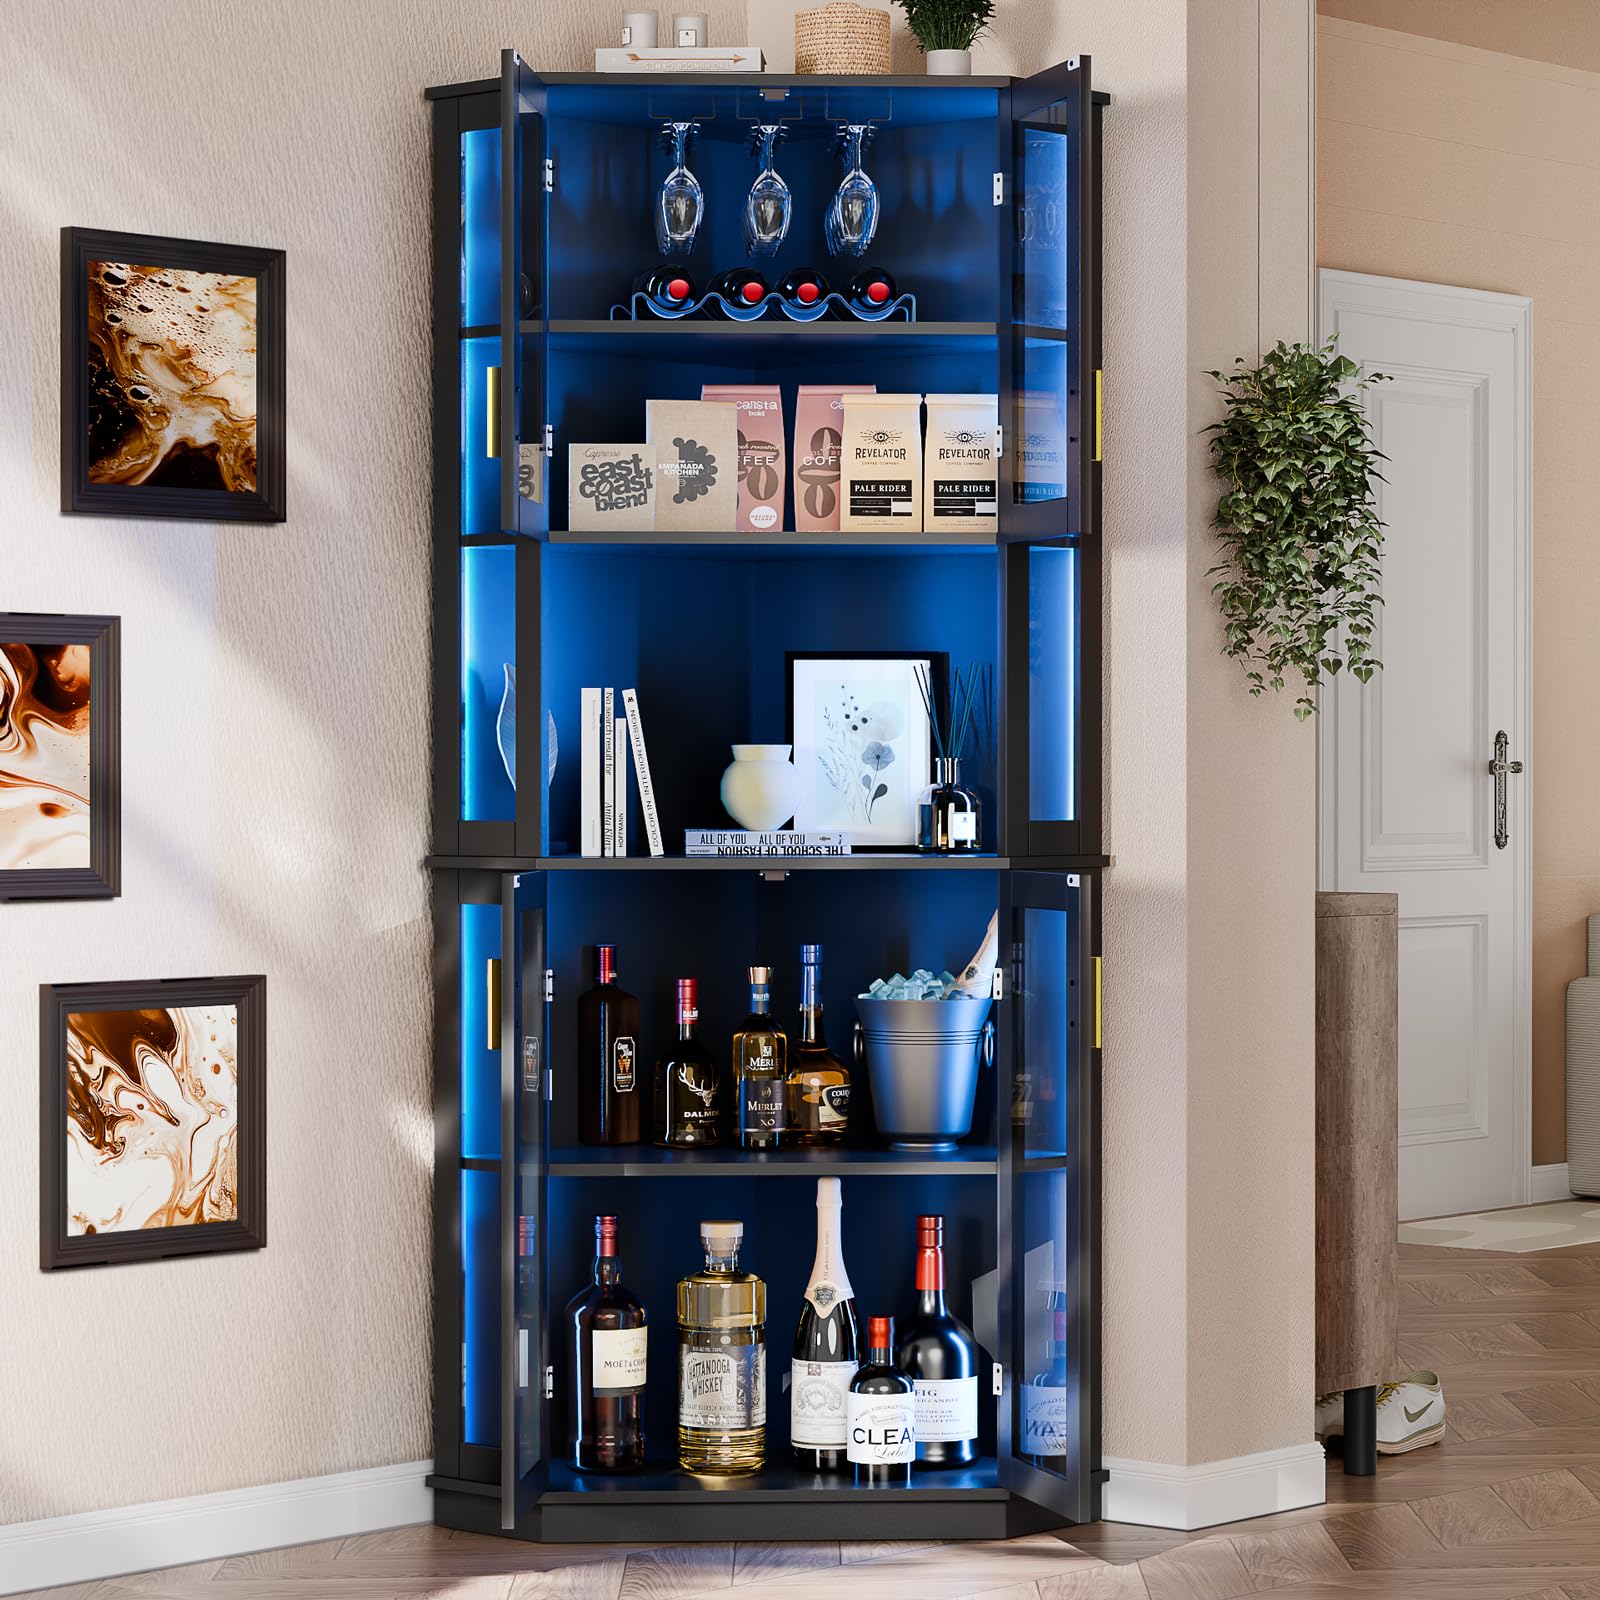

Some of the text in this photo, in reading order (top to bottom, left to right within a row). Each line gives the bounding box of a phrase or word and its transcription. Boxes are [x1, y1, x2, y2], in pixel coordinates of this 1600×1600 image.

[735, 400, 778, 410] calista
[855, 448, 906, 460] REVELATOR
[939, 448, 990, 460] REVELATOR
[581, 453, 642, 480] east
[803, 456, 837, 466] COF
[579, 468, 653, 498] coast
[854, 484, 906, 492] PALE RIDER
[938, 484, 990, 492] PALE RIDER
[595, 488, 648, 512] blend
[605, 692, 613, 704] No
[605, 706, 613, 736] search
[605, 763, 613, 776] for
[630, 710, 658, 848] COLOR IN INTERIOR DESIGN
[700, 834, 746, 844] ALL OF YOU
[759, 834, 806, 844] ALL OF YOU
[718, 846, 843, 856] THE SCHOOL OF FASHION
[748, 1101, 782, 1111] MERLET
[760, 1118, 775, 1126] XO
[692, 1376, 723, 1400] WHISKEY
[914, 1389, 938, 1397] FIG
